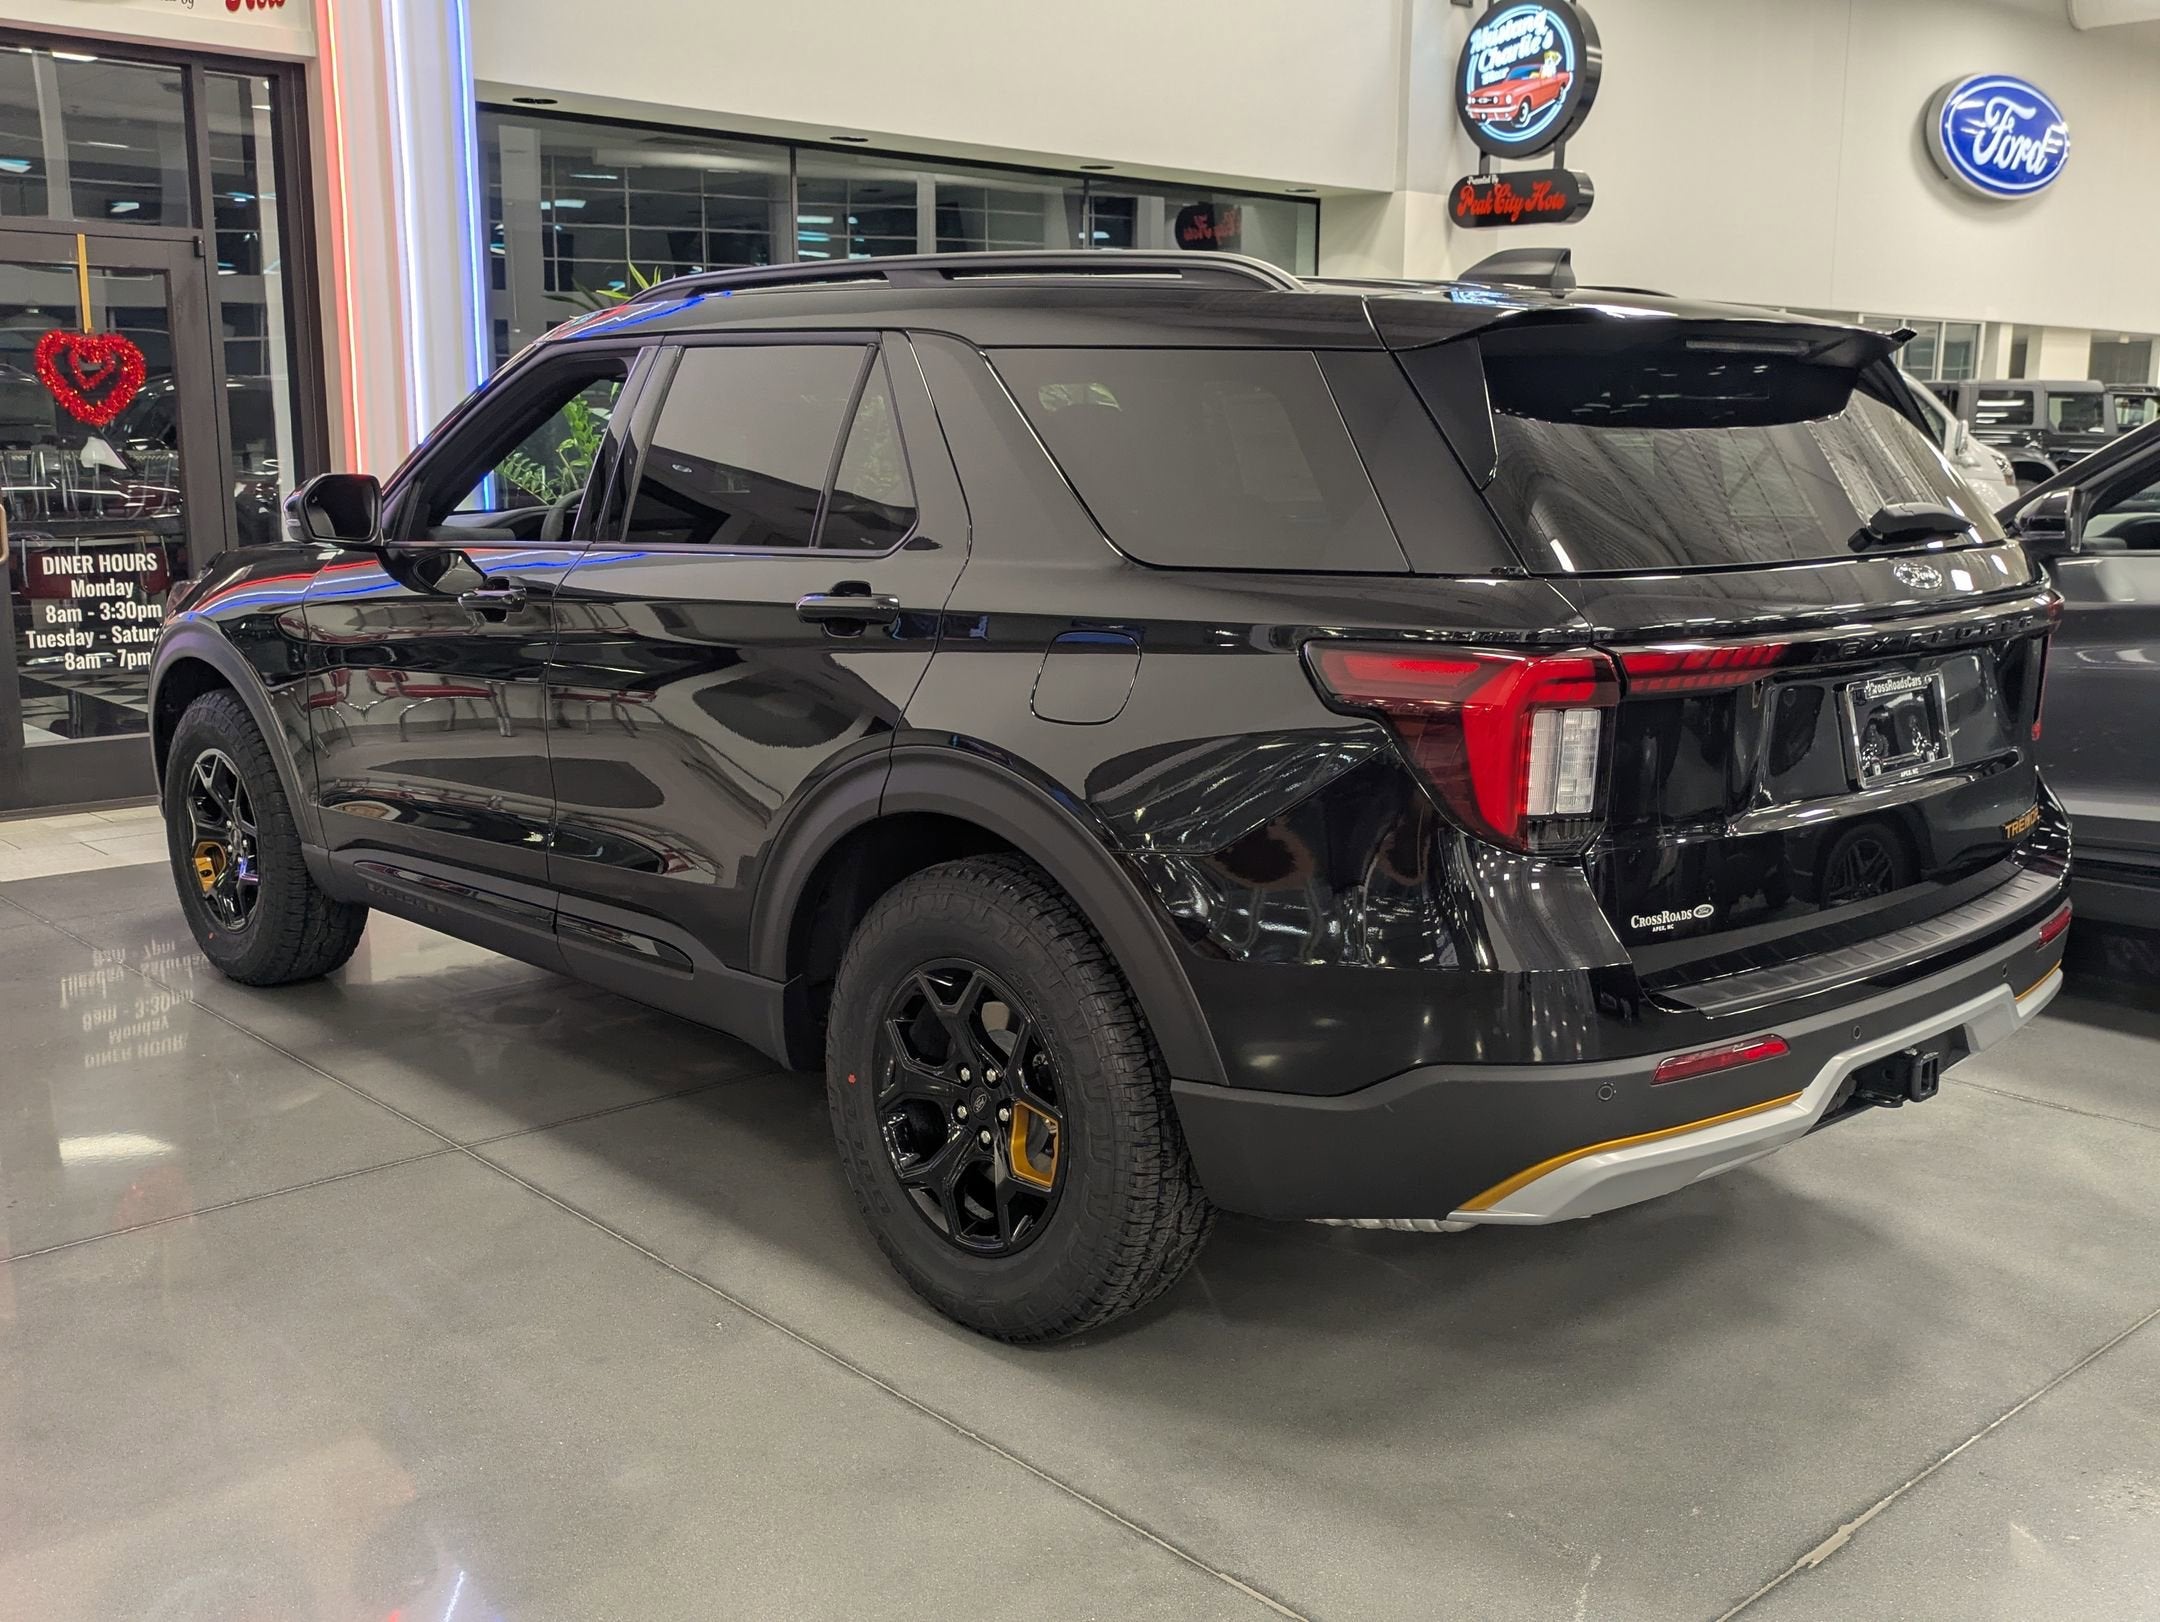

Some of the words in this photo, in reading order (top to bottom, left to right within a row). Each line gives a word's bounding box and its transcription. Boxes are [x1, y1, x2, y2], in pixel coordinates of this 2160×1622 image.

[1972, 96, 2051, 175] Ford
[1494, 182, 1524, 222] City
[41, 554, 95, 575] DINER
[98, 552, 158, 573] HOURS
[70, 578, 134, 598] Monday
[45, 604, 83, 624] 8am
[99, 601, 163, 622] 3:30pm
[25, 627, 95, 649] Tuesday
[64, 652, 102, 671] 8am
